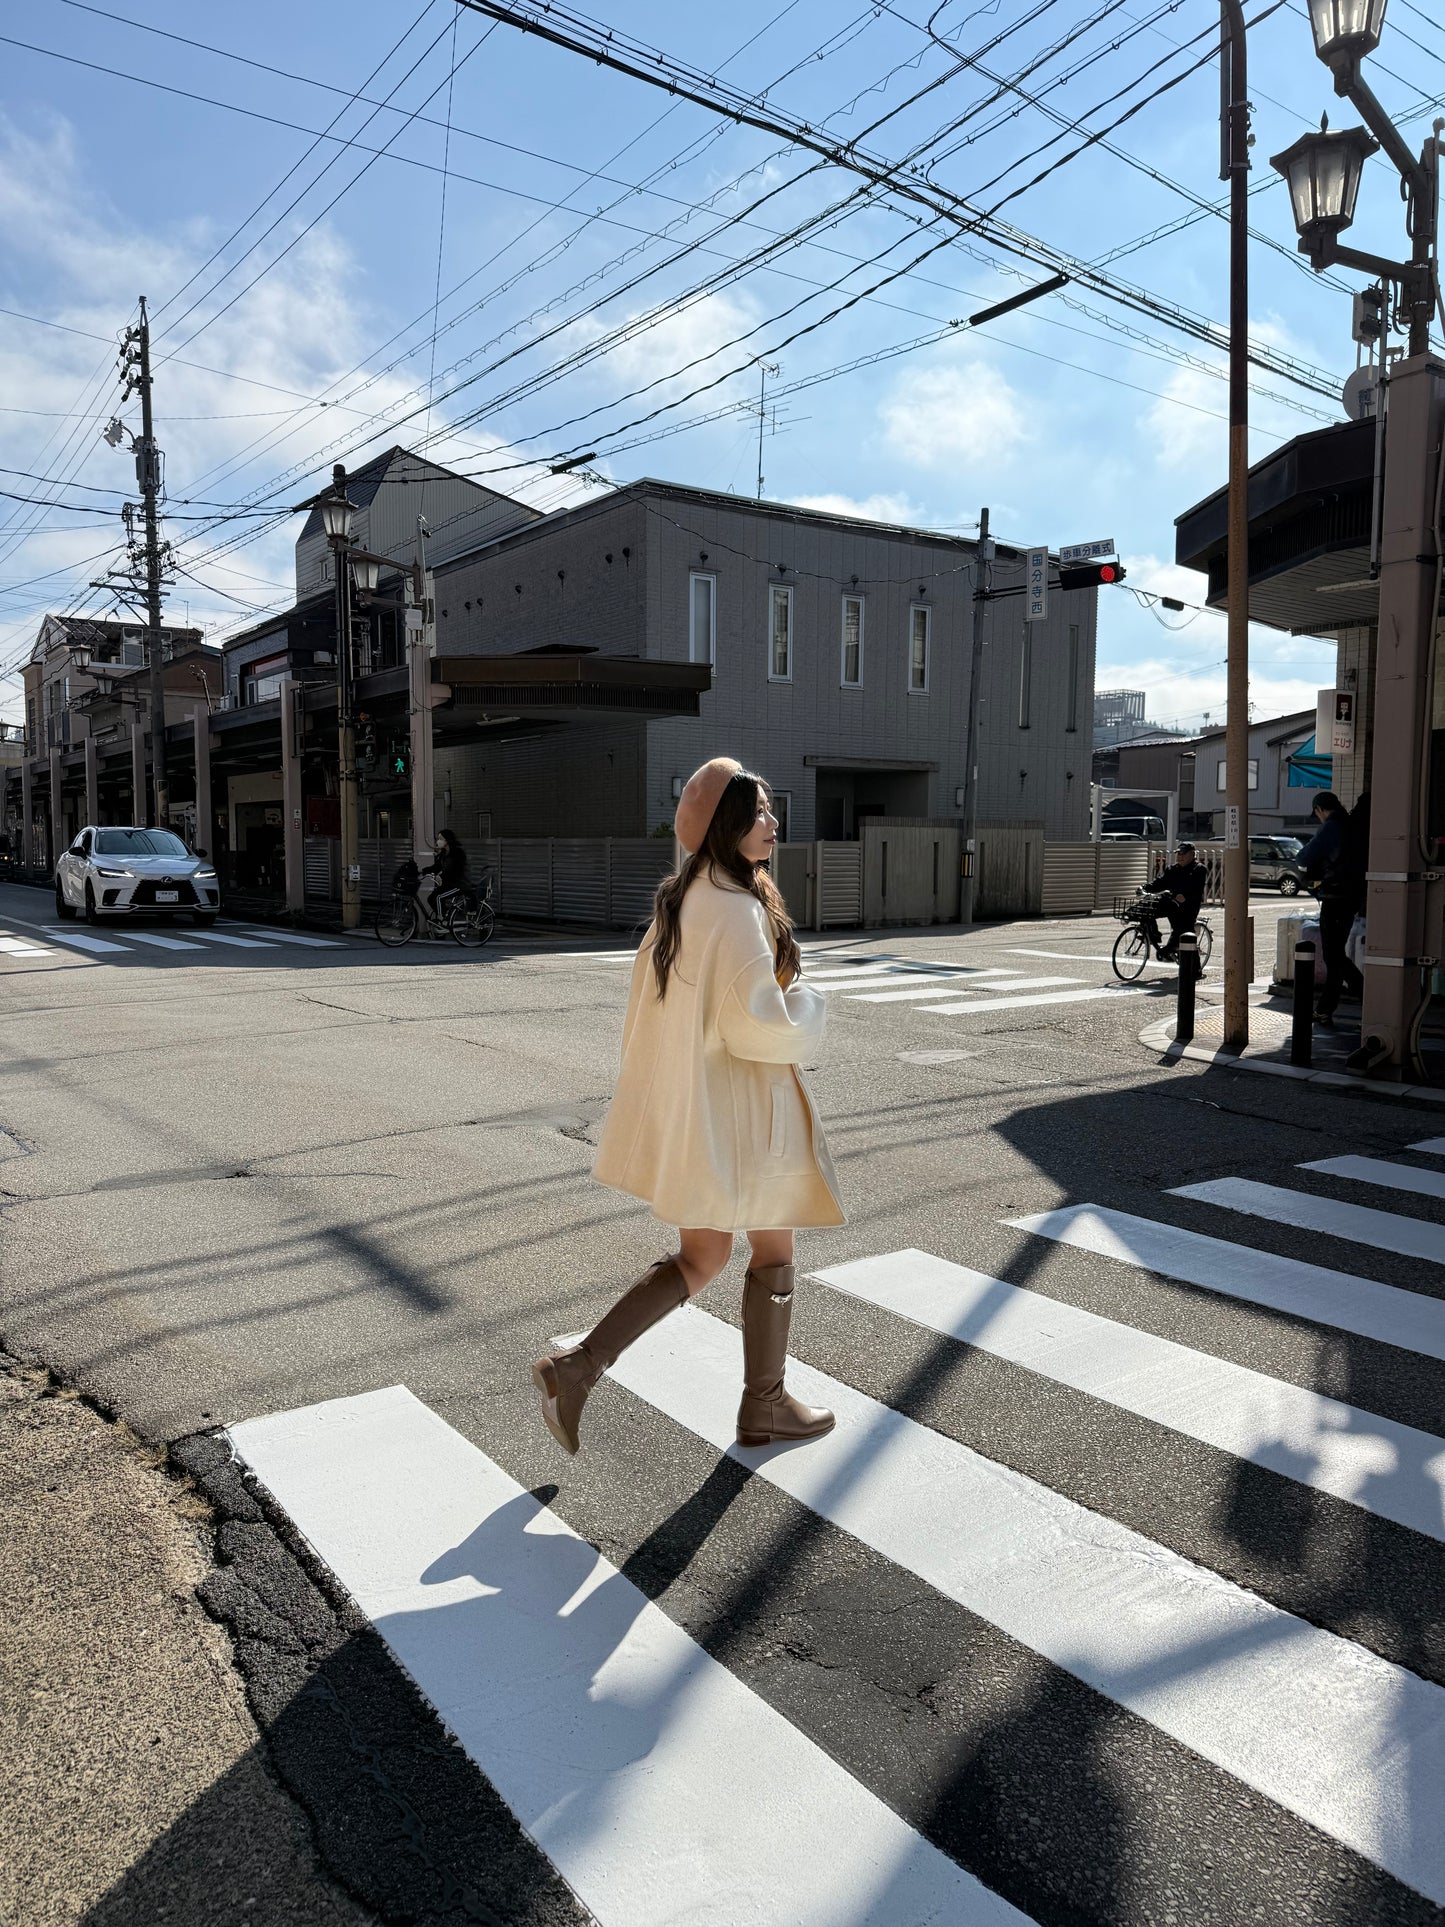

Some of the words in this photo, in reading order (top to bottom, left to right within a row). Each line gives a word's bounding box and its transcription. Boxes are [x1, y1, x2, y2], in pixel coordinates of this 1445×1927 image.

[1063, 543, 1111, 560] 歩車分離式
[1032, 554, 1043, 613] 国分寺西
